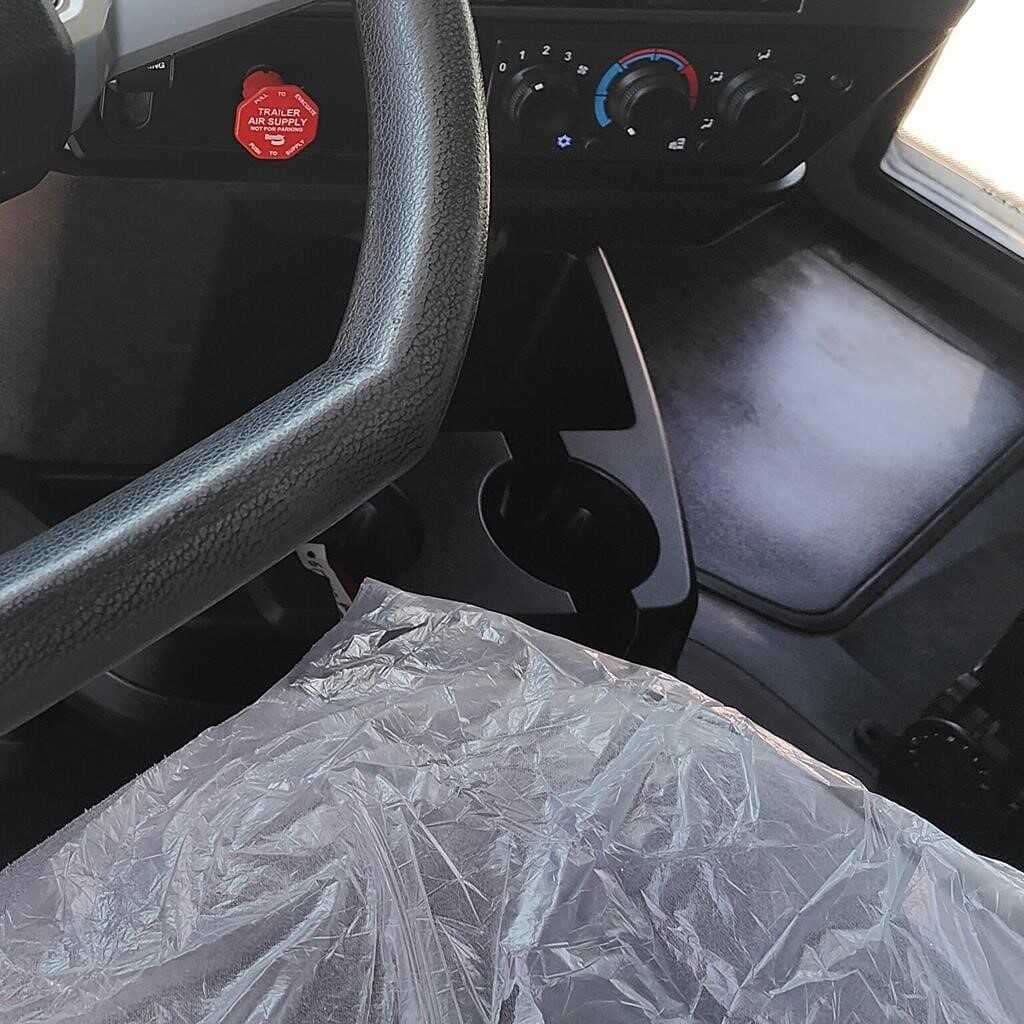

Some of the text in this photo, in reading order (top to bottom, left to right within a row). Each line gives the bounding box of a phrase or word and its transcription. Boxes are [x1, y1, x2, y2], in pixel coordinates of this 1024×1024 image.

[519, 50, 526, 60] 1
[542, 45, 551, 56] 2
[564, 51, 572, 62] 3
[499, 62, 506, 72] 0
[258, 107, 301, 117] TRAILER
[248, 117, 308, 127] AIR SUPPLY
